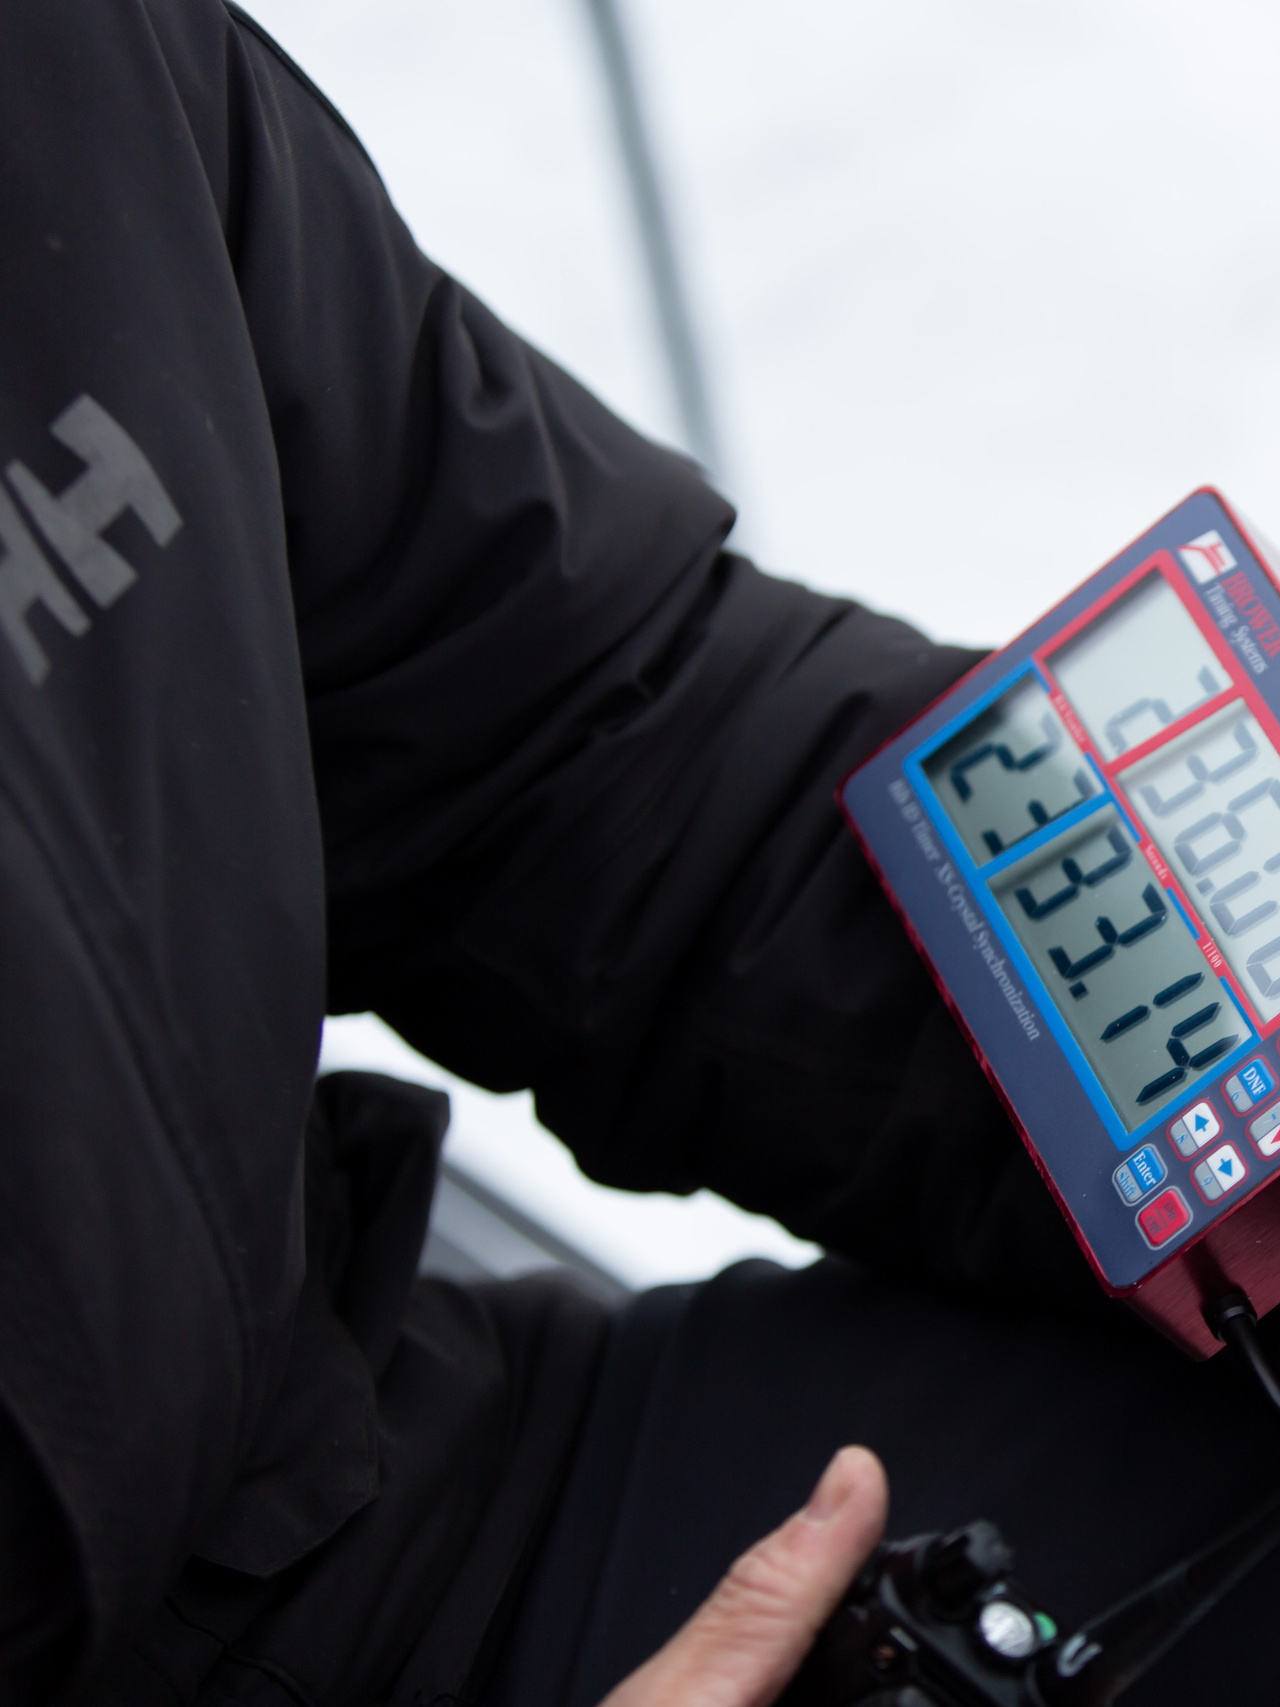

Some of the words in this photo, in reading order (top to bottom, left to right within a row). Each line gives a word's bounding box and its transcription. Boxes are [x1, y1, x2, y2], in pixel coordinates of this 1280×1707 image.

[1204, 583, 1240, 628] Timing
[1227, 624, 1268, 675] Systems
[974, 930, 1039, 1041] Synchronization
[1012, 823, 1241, 1104] 33.14
[1242, 1066, 1266, 1097] DNF
[1116, 1172, 1137, 1198] Shift
[1133, 1151, 1156, 1187] Enter
